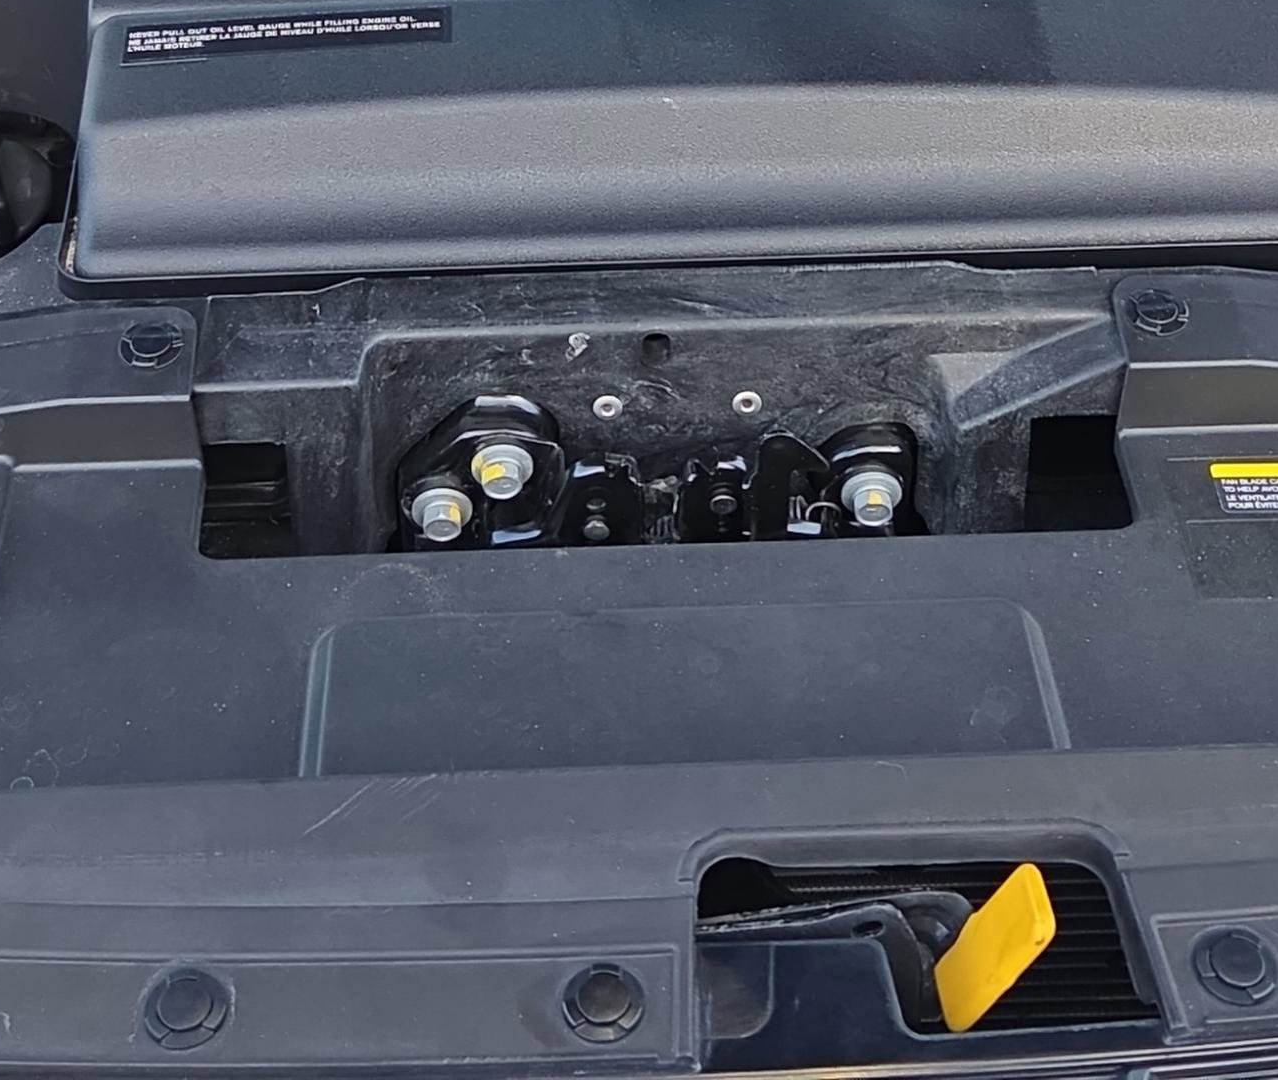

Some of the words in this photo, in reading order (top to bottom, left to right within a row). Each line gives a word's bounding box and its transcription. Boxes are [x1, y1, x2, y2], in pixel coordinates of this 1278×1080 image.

[129, 30, 160, 39] NEVER
[162, 29, 185, 37] PULL
[210, 26, 225, 34] OIL
[227, 25, 255, 33] LEVEL
[257, 22, 291, 30] GAUGE
[293, 20, 322, 29] WHILE
[324, 19, 359, 27] FILLING
[361, 17, 397, 25] ENGINE
[399, 15, 418, 23] OIL.
[143, 37, 177, 45] JAMAIS
[179, 34, 217, 42] RETIRER
[233, 31, 263, 39] JAUGE
[281, 27, 314, 36] NIVEAU
[316, 25, 353, 34] D'HUILE
[411, 21, 441, 29] VERSE
[127, 44, 162, 52] L'HUILE
